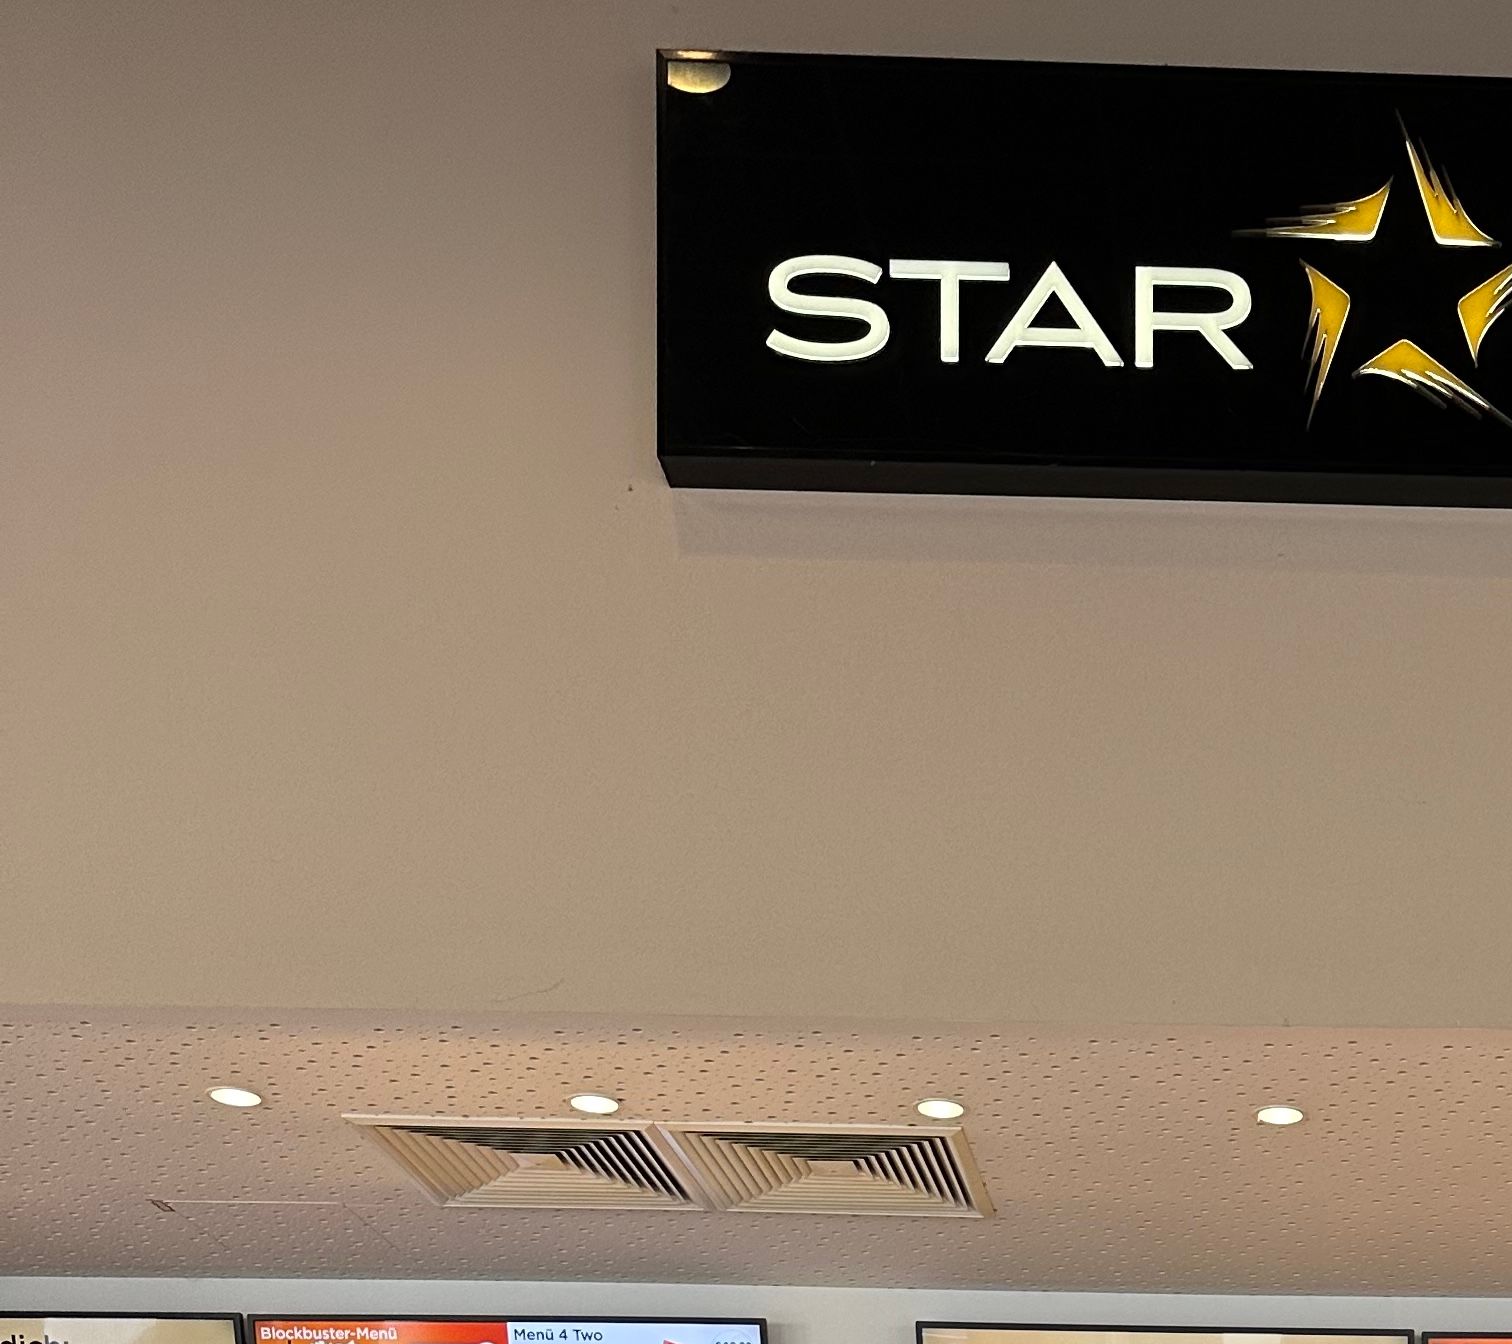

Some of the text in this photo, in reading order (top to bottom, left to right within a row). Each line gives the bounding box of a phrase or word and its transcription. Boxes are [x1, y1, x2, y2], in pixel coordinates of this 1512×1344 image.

[765, 254, 1255, 372] STAR
[261, 1326, 397, 1340] Blockbuster-Menü
[514, 1328, 603, 1341] Menü 4 Two
